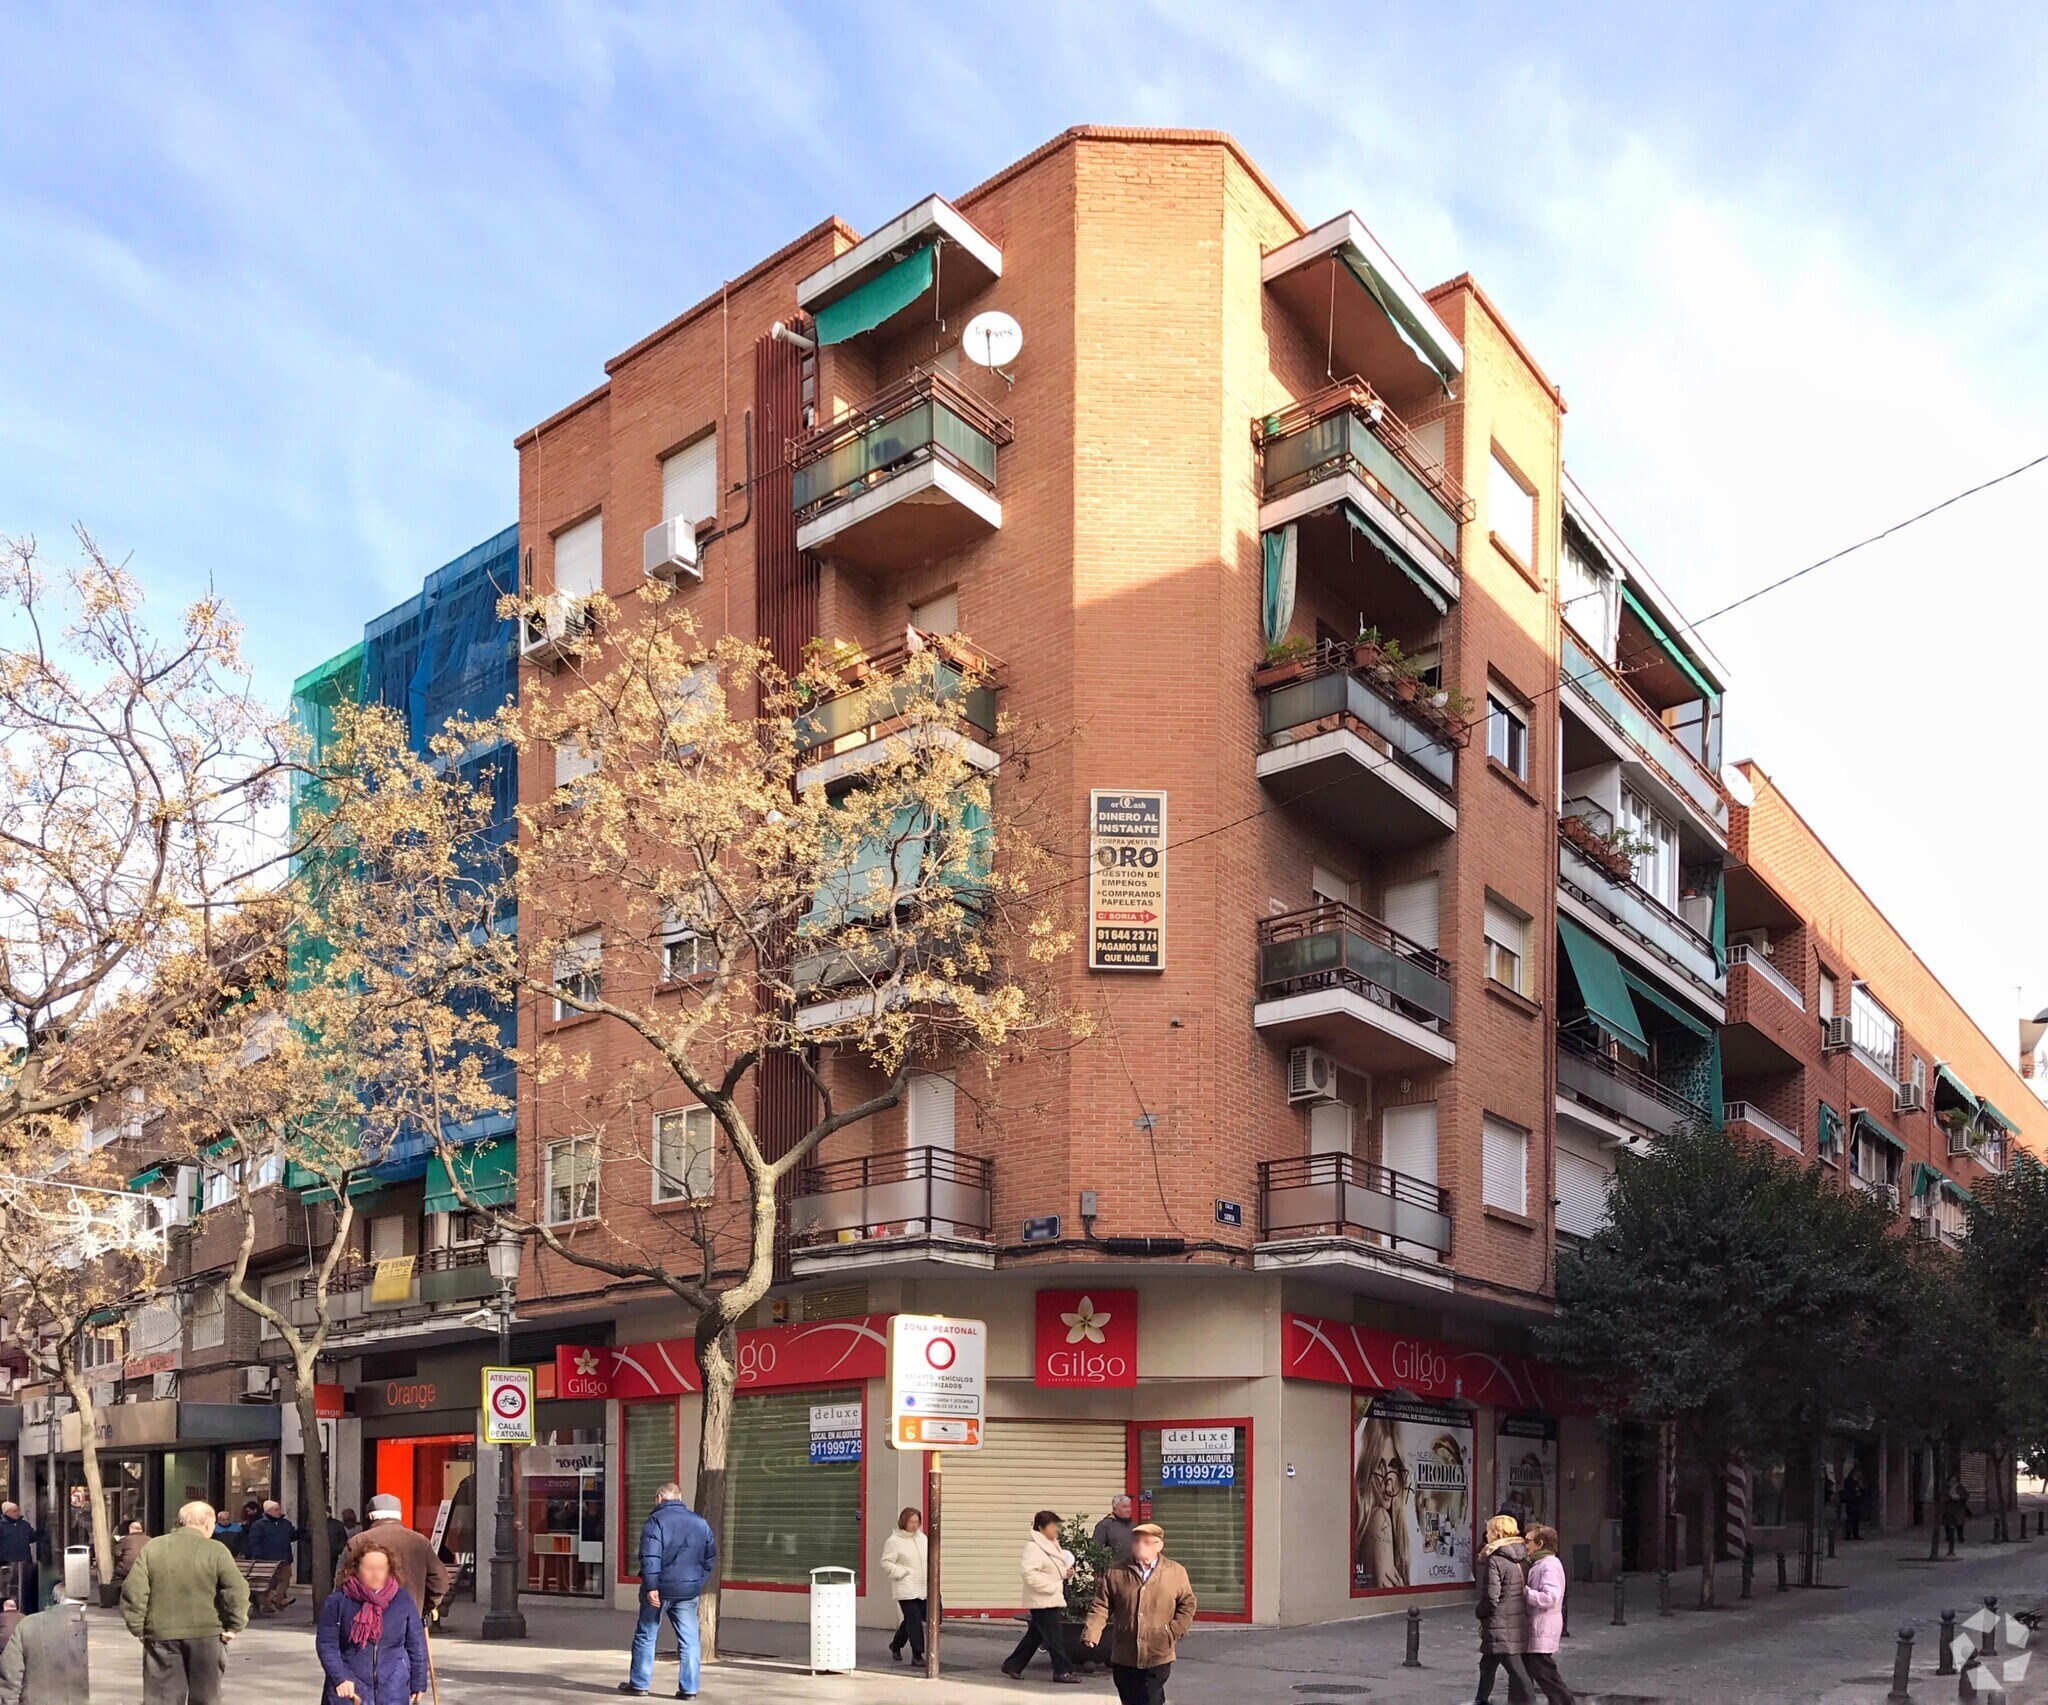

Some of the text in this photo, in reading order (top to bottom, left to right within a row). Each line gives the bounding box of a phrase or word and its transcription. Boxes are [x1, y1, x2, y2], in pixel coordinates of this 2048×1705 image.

[1099, 813, 1158, 822] DINERO AL
[1099, 824, 1158, 834] INSTANTE
[1098, 846, 1158, 868] ORO
[1102, 870, 1160, 879] GESTIÓN DE
[1102, 878, 1148, 887] EMPEÑOS
[1098, 930, 1157, 940] 91 644 23 71
[1097, 942, 1157, 952] PAGAMOS MAS
[1104, 954, 1150, 963] QUE NADIE
[933, 1326, 977, 1335] PEATONAL
[1048, 1350, 1126, 1382] Gilgo
[1392, 1341, 1446, 1390] Gilgo
[490, 1374, 528, 1382] ATENCIÓN
[568, 1378, 607, 1396] Gilgo
[387, 1382, 436, 1409] Orange
[814, 1408, 858, 1419] deluxe
[812, 1430, 861, 1440] LOCAL EN ALQUILER
[1168, 1431, 1228, 1441] deluxe
[810, 1440, 862, 1455] 911999729
[1164, 1455, 1232, 1463] LOCAL EN ALQUILER
[1162, 1465, 1234, 1479] 911999729
[1419, 1464, 1464, 1482] PRODIGY
